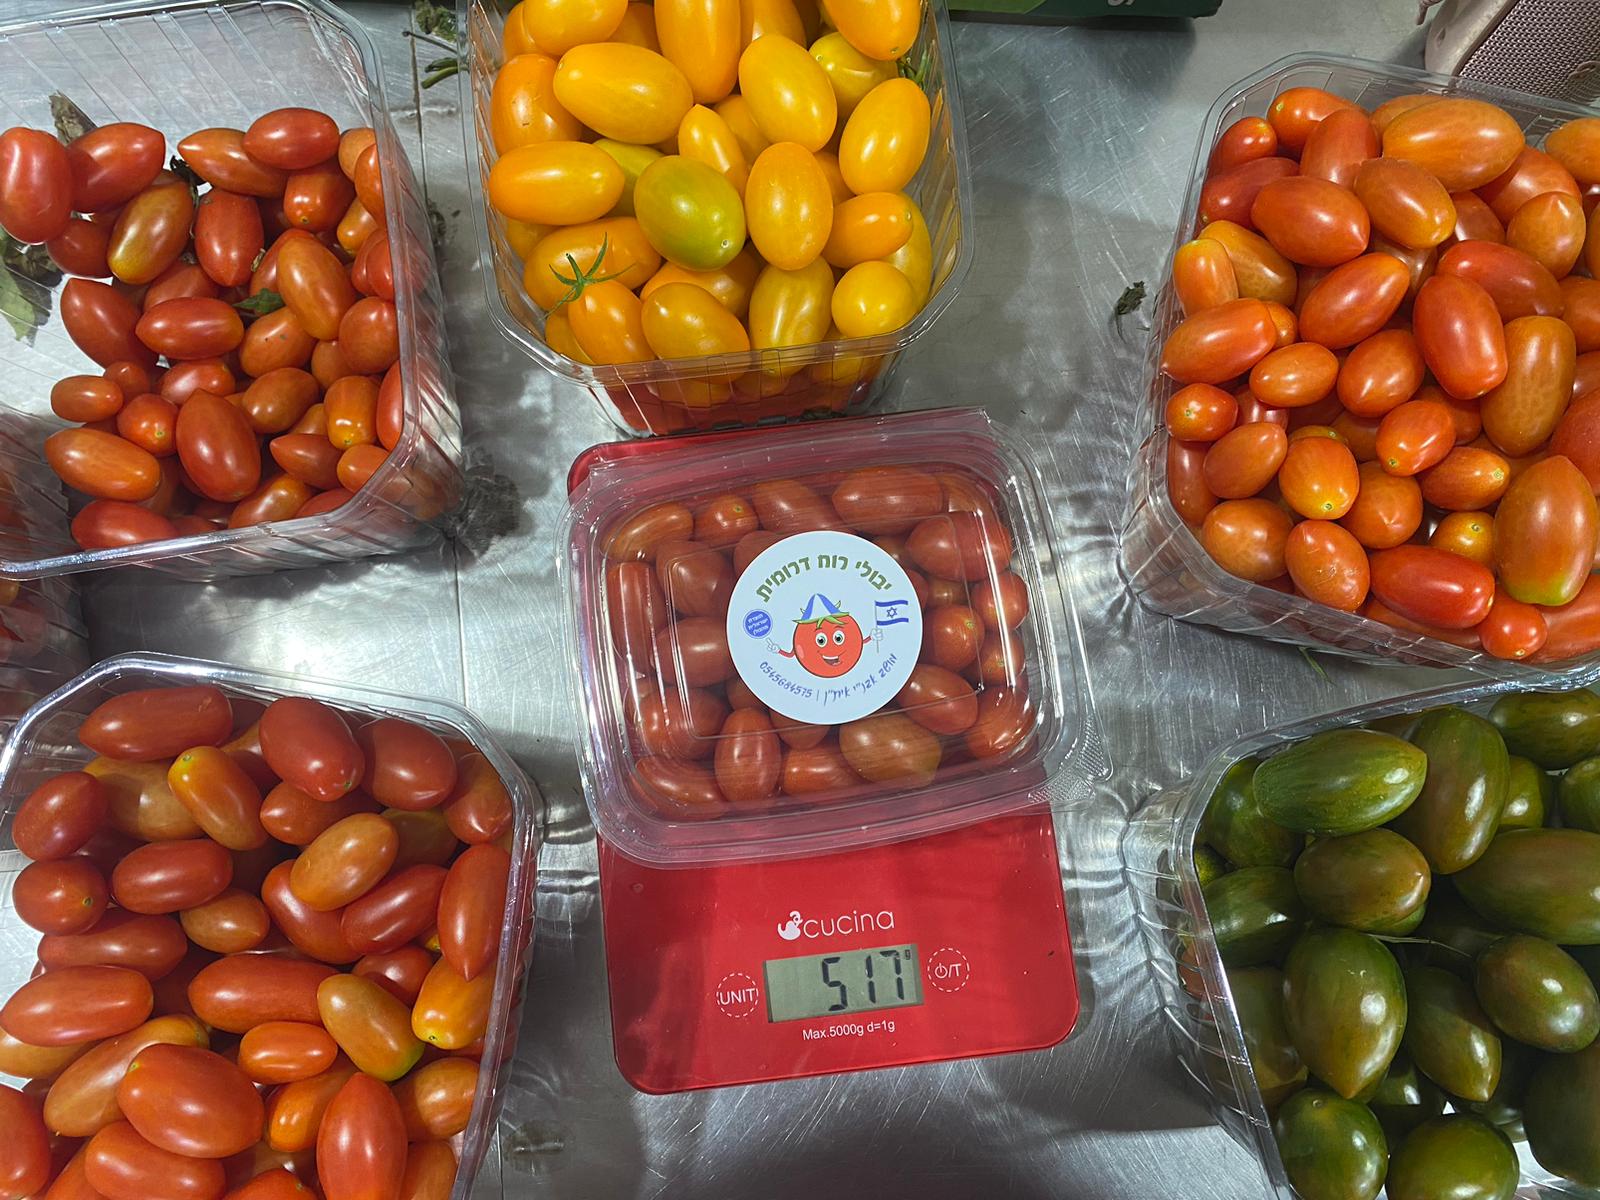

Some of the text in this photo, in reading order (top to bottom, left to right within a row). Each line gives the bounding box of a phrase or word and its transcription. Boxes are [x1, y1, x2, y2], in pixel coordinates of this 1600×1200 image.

[756, 554, 893, 603] יבולי רוח דרומית
[759, 661, 813, 698] 0545684575
[803, 909, 896, 939] cucina
[718, 988, 756, 1006] UNIT
[821, 949, 905, 1012] 517
[802, 1020, 896, 1041] Max.5000g d=1g
